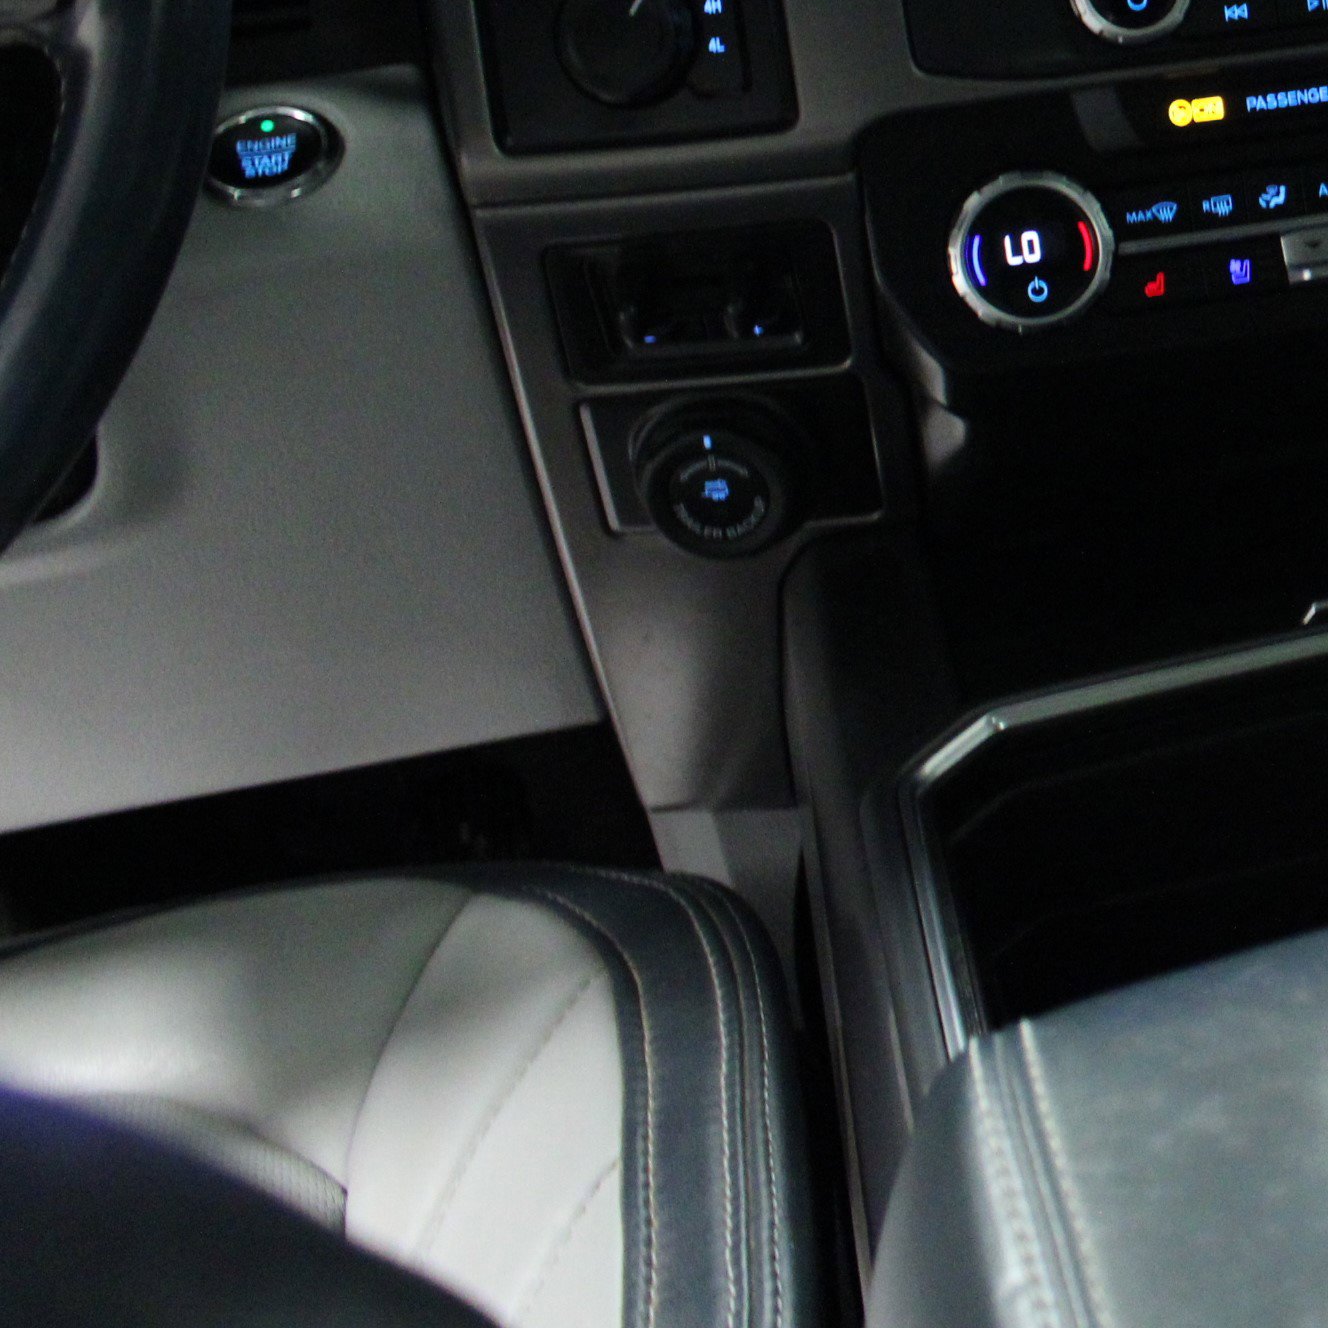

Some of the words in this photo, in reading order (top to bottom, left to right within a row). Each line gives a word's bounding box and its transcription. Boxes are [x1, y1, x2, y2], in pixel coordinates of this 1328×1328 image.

[708, 37, 726, 54] 4L
[235, 132, 297, 153] ENGINE
[1126, 207, 1154, 224] MAX
[1004, 230, 1042, 266] LO
